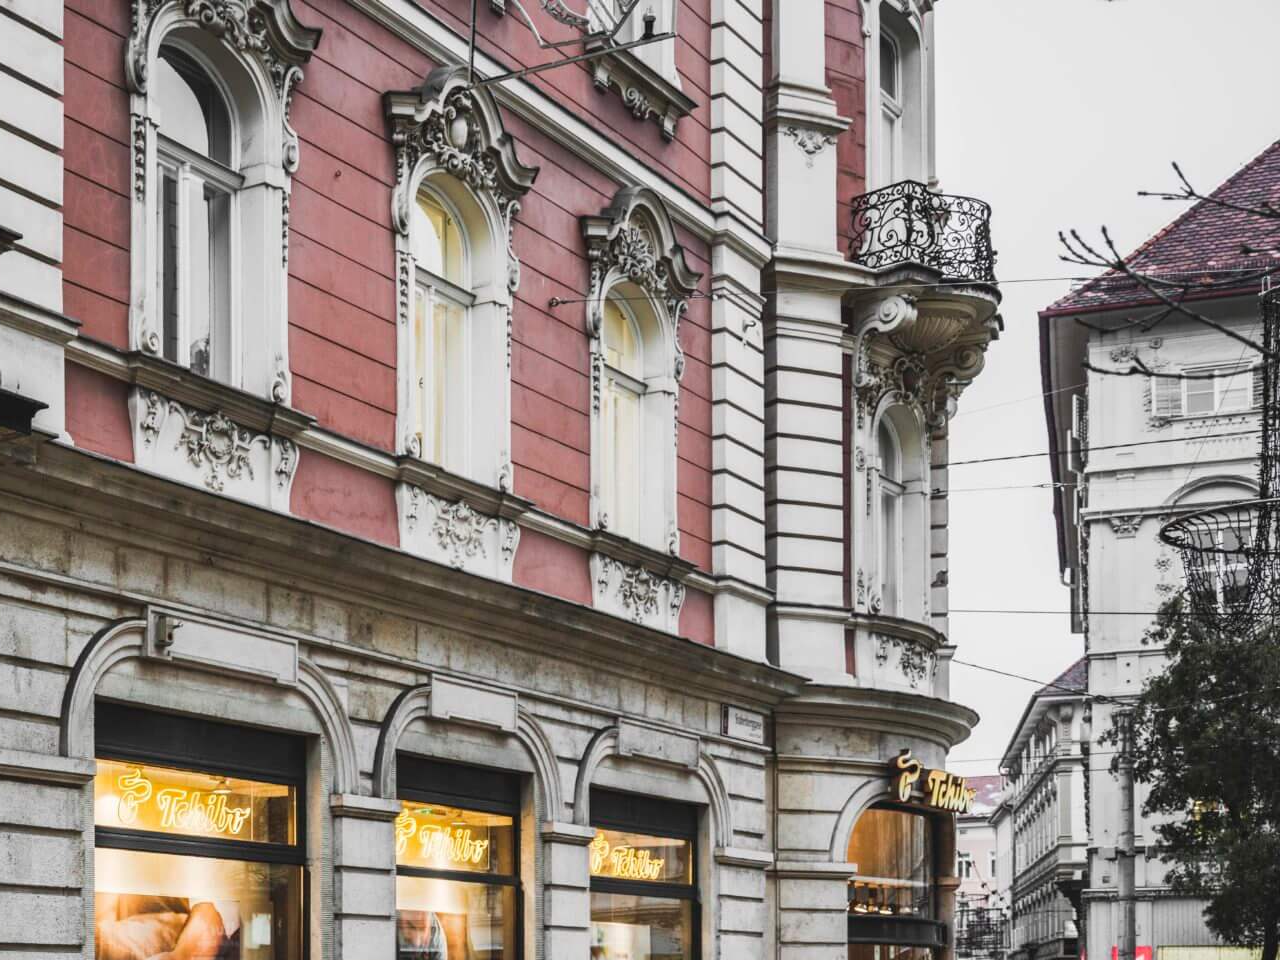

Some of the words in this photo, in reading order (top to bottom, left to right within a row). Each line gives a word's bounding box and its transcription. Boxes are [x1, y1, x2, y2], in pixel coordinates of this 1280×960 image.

[157, 788, 251, 834] Tchibo
[928, 769, 976, 814] Tchibo
[420, 824, 489, 863] Tchibo
[611, 845, 664, 879] Tchibo
